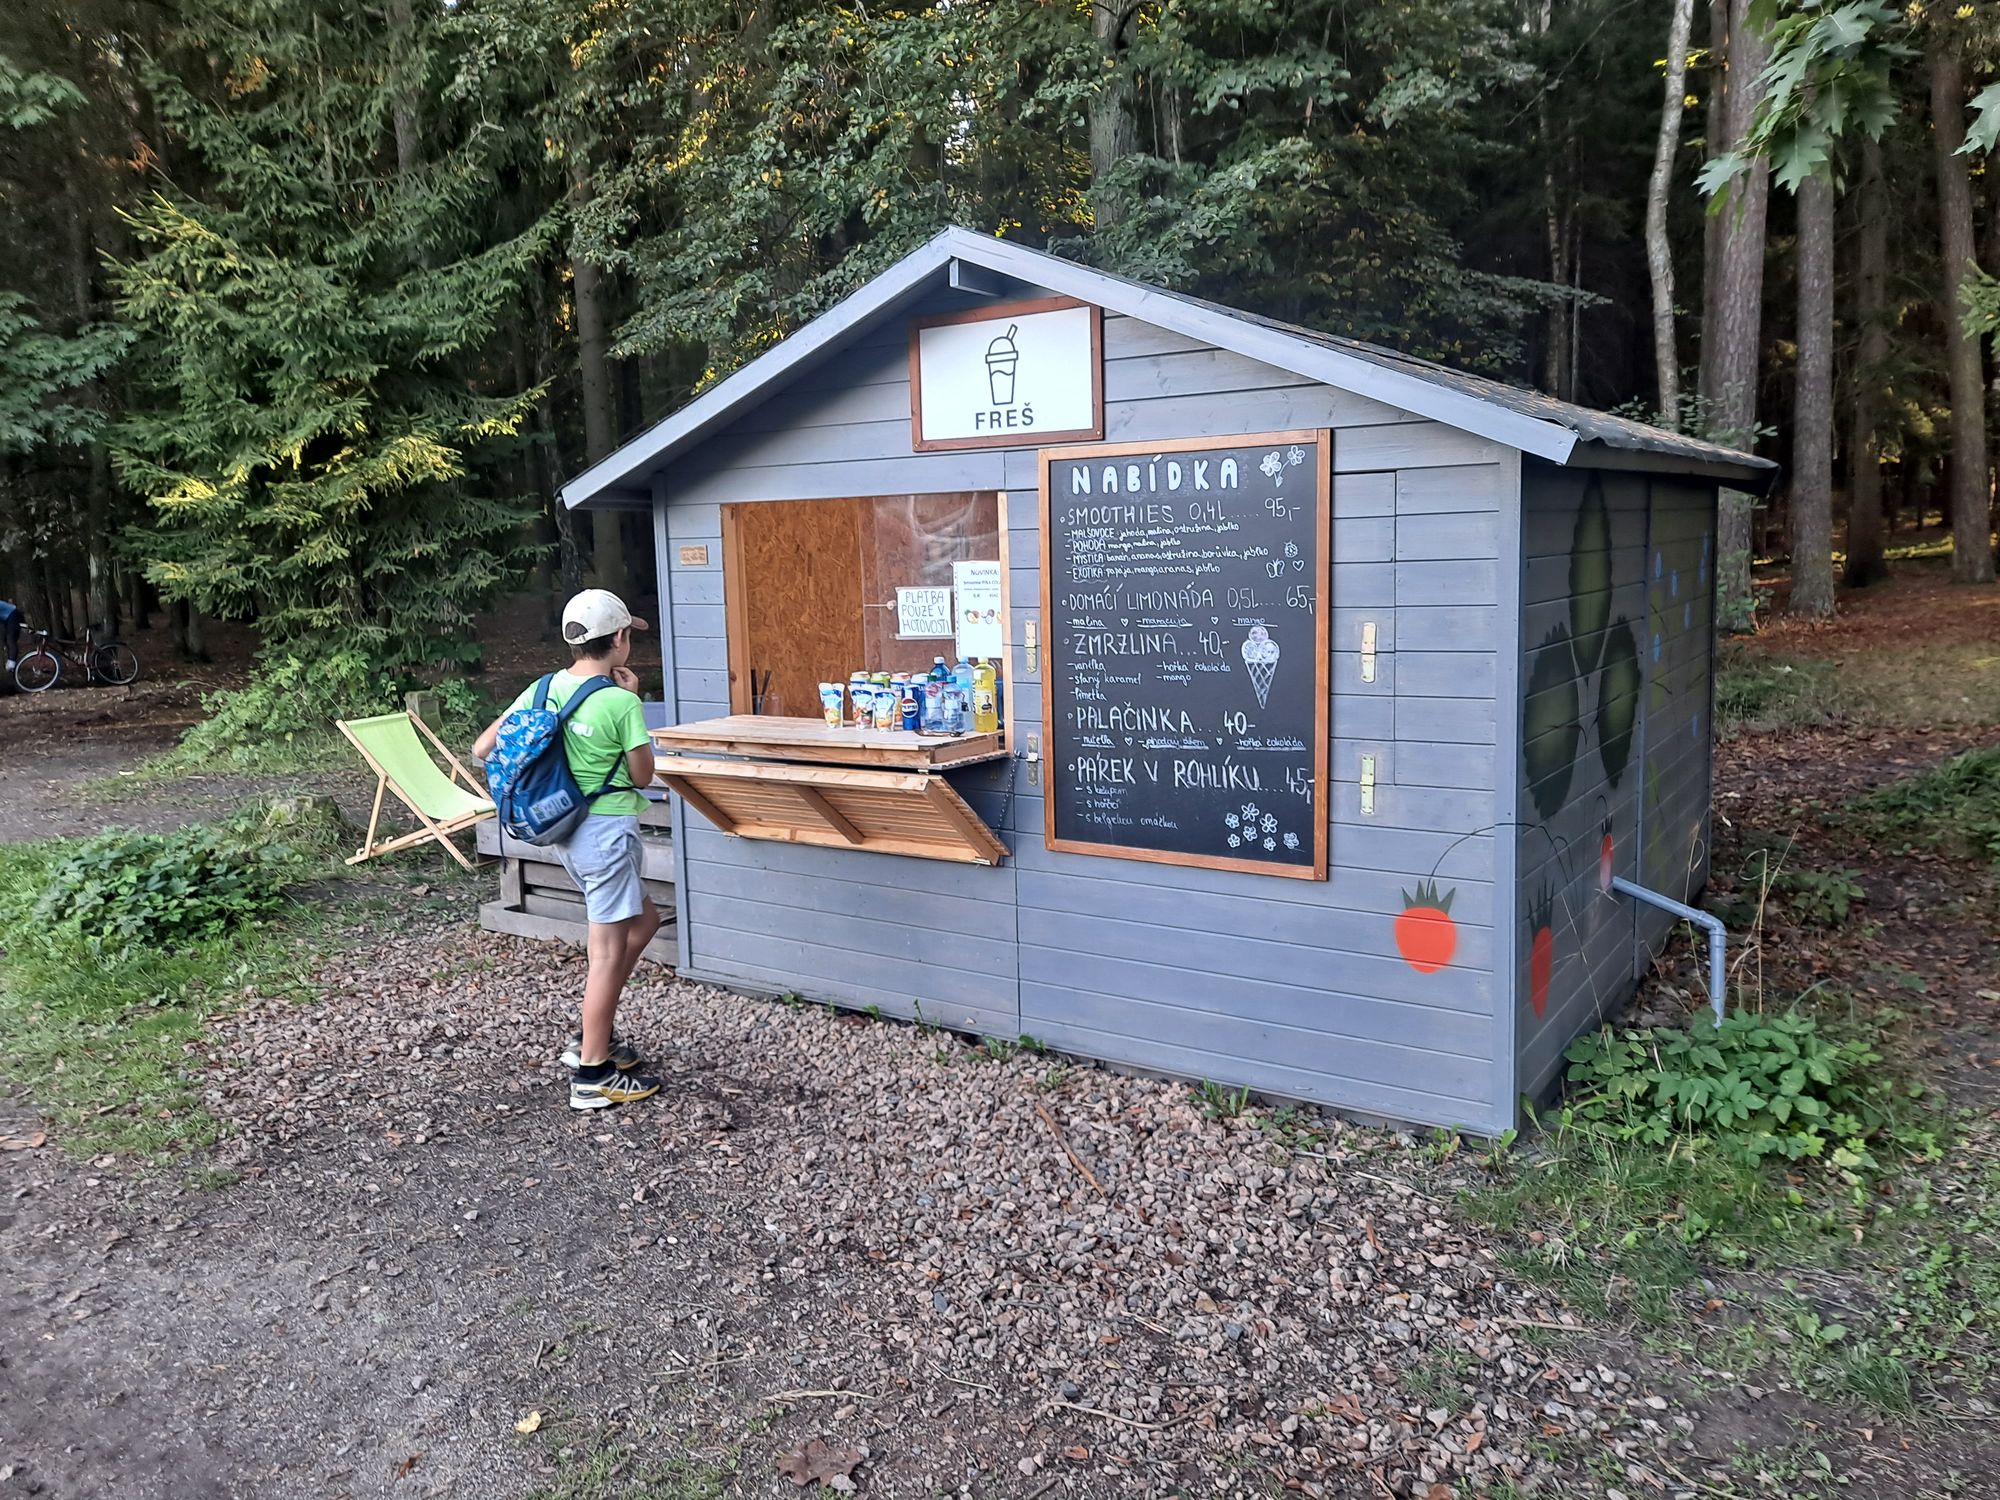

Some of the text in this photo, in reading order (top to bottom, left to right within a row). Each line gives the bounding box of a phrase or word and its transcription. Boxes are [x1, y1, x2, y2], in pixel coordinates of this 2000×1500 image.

[975, 402, 1034, 430] FREŠ
[1072, 454, 1238, 494] NABÍDKA
[1068, 504, 1174, 525] SMOOTHIES
[1264, 498, 1300, 521] 95,-
[1217, 522, 1239, 533] jablko
[1072, 539, 1106, 552] POHODA
[1160, 537, 1180, 549] jablko
[1243, 546, 1269, 560] jablko
[1195, 563, 1220, 576] jablko
[905, 591, 944, 604] PLATBA
[1069, 583, 1123, 610] DOMÁCÍ
[1127, 581, 1214, 610] LIMONÁDA
[902, 605, 945, 617] POUZE V
[902, 618, 950, 634] HOTOVOSTI
[1073, 632, 1177, 656] ZMRZLINA
[1075, 672, 1141, 689] slaný karamel
[1163, 675, 1192, 687] mango
[1076, 701, 1195, 734] PALAČINKA
[1083, 735, 1114, 745] nutella
[1077, 752, 1136, 784] PÁREK
[1143, 760, 1158, 781] V
[1174, 755, 1260, 791] ROHLÍKU
